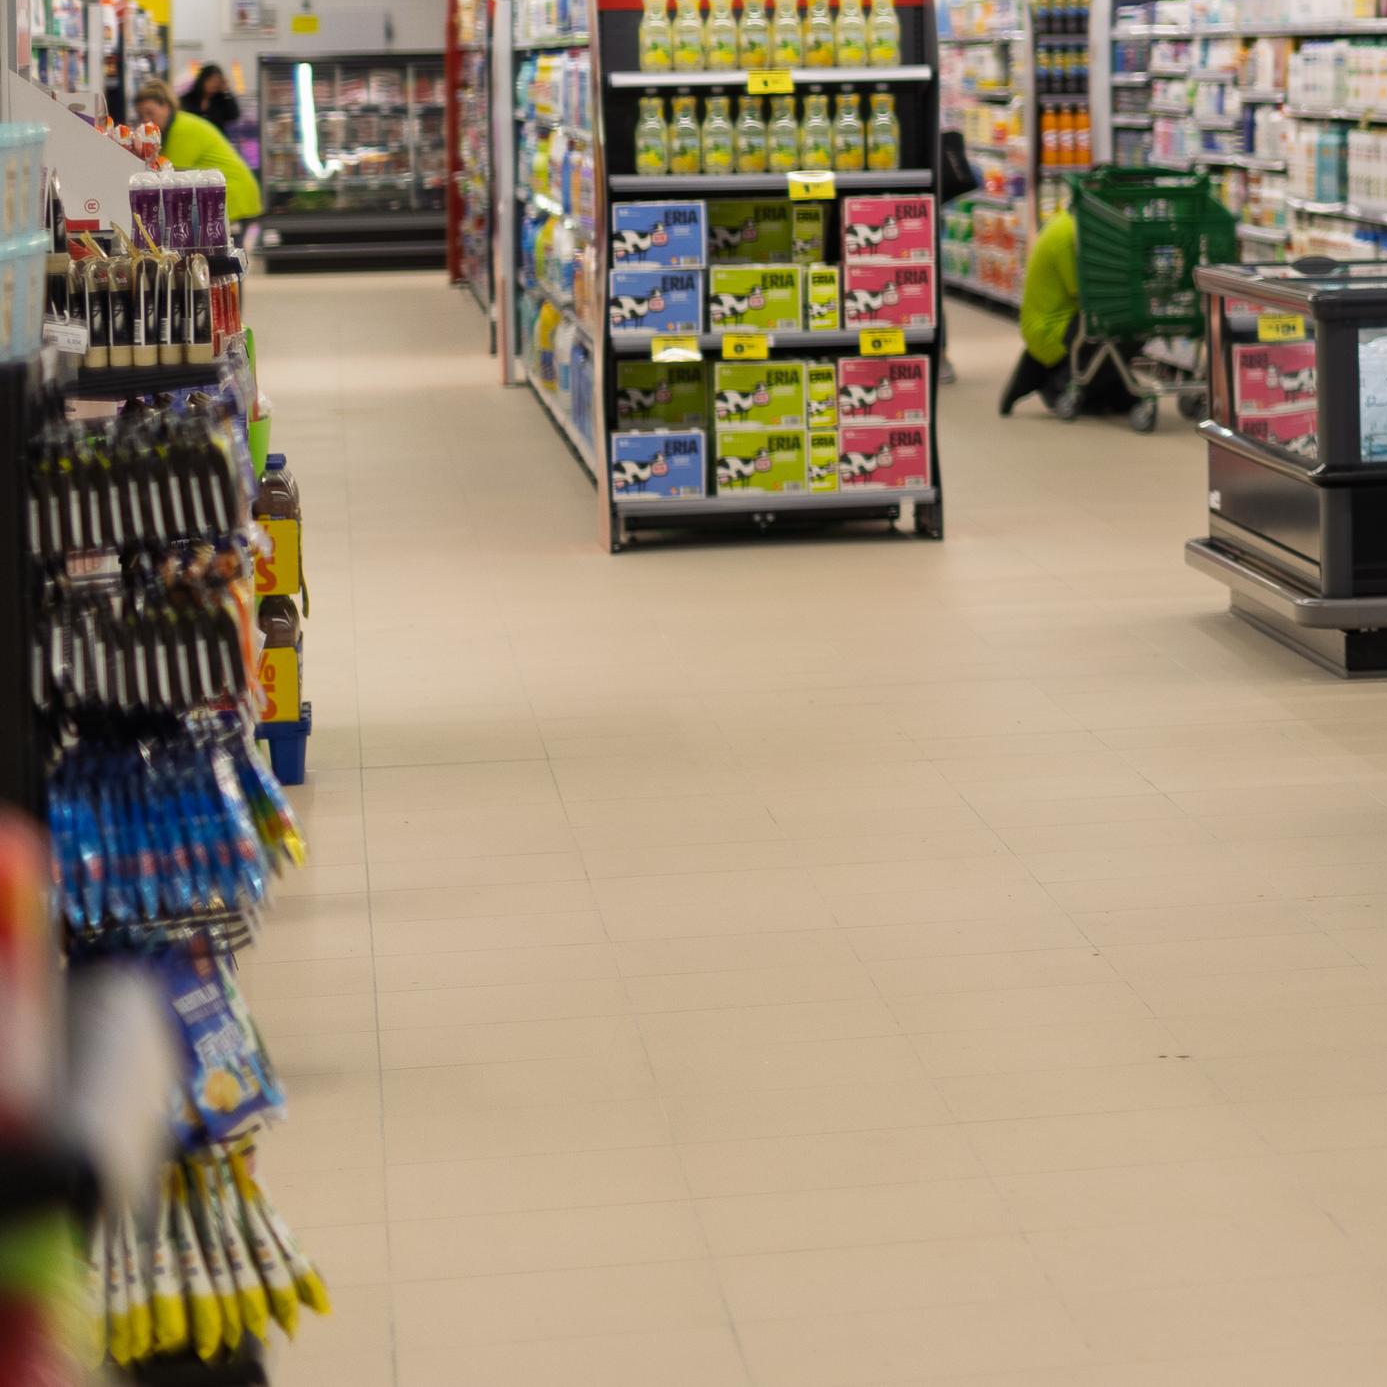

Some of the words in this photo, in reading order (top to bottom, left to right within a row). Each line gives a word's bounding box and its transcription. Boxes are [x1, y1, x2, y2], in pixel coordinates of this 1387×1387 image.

[663, 209, 698, 226] ERIA
[754, 205, 788, 223] ERIA
[895, 203, 929, 220] ERIA
[661, 274, 696, 292] ERIA
[761, 273, 796, 290] ERIA
[811, 274, 836, 286] ERIA
[895, 269, 929, 286] ERIA
[766, 369, 799, 386] ERIA
[809, 370, 833, 383] ERIA
[889, 364, 923, 381] ERIA
[664, 438, 698, 456] ERIA
[767, 436, 802, 453] ERIA
[811, 435, 836, 448] ERIA
[889, 430, 923, 448] ERIA
